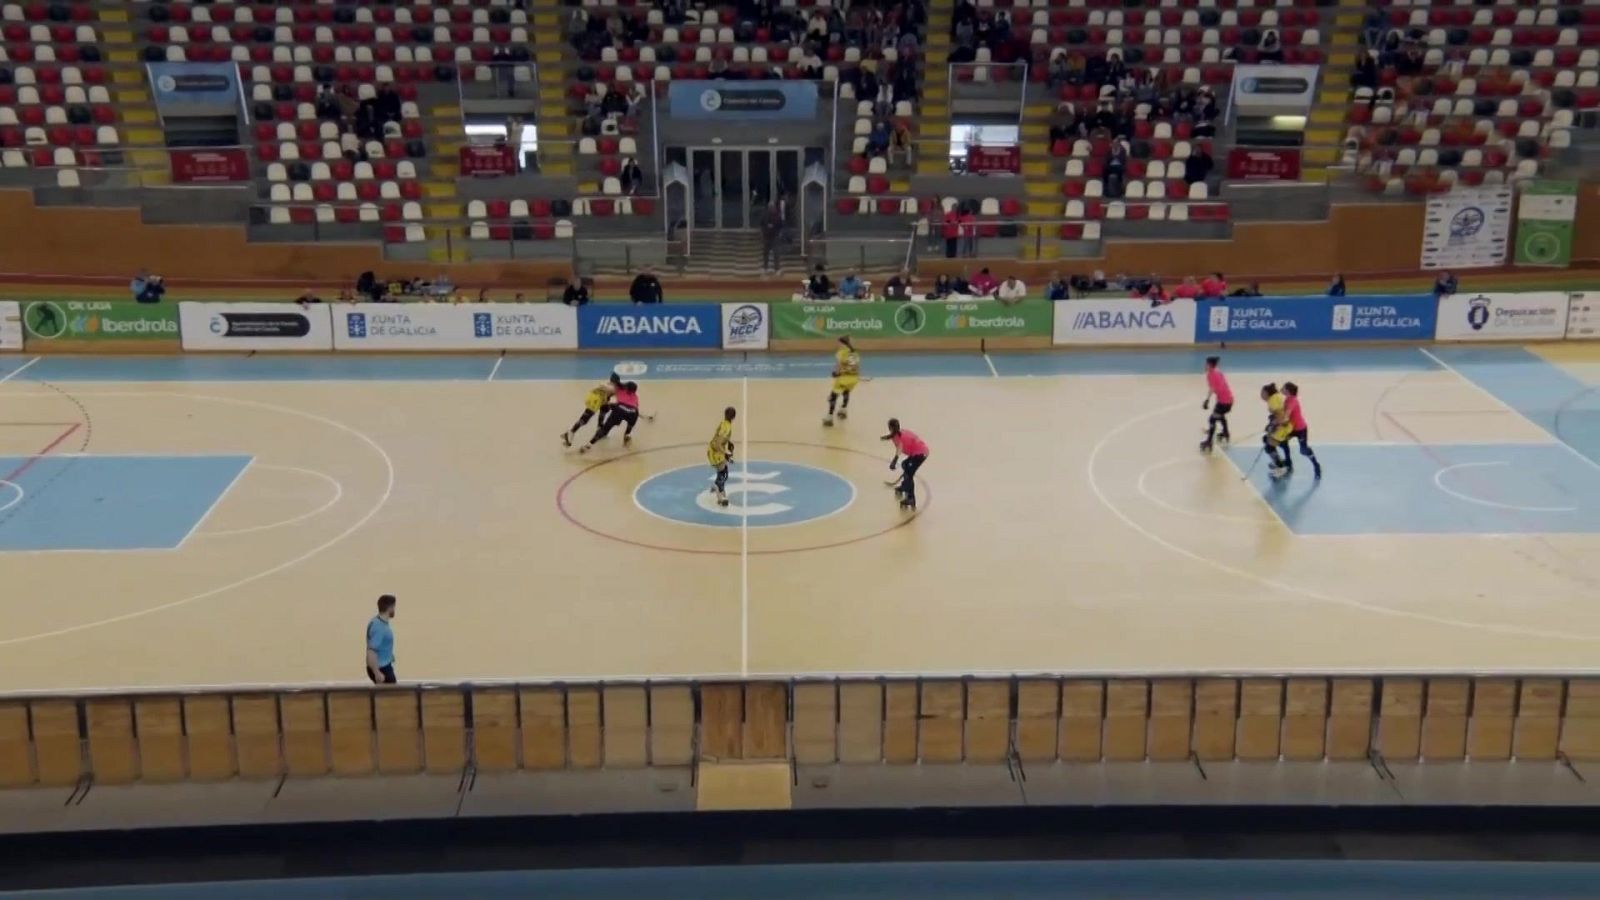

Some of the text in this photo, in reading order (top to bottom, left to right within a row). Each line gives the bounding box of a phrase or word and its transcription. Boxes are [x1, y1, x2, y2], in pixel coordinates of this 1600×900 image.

[1233, 308, 1273, 317] XUNTA
[1357, 306, 1397, 316] XUNTA
[371, 315, 412, 324] XUNTA
[497, 315, 536, 324] XUNTA
[826, 318, 883, 329] Iberdrola
[968, 316, 1025, 328] Iberdrola
[1231, 319, 1297, 329] DE GALICIA
[1355, 317, 1421, 328] DE GALICIA
[102, 318, 177, 332] Iberdrola
[370, 326, 436, 336] DE GALICIA
[496, 326, 561, 336] DE GALICIA
